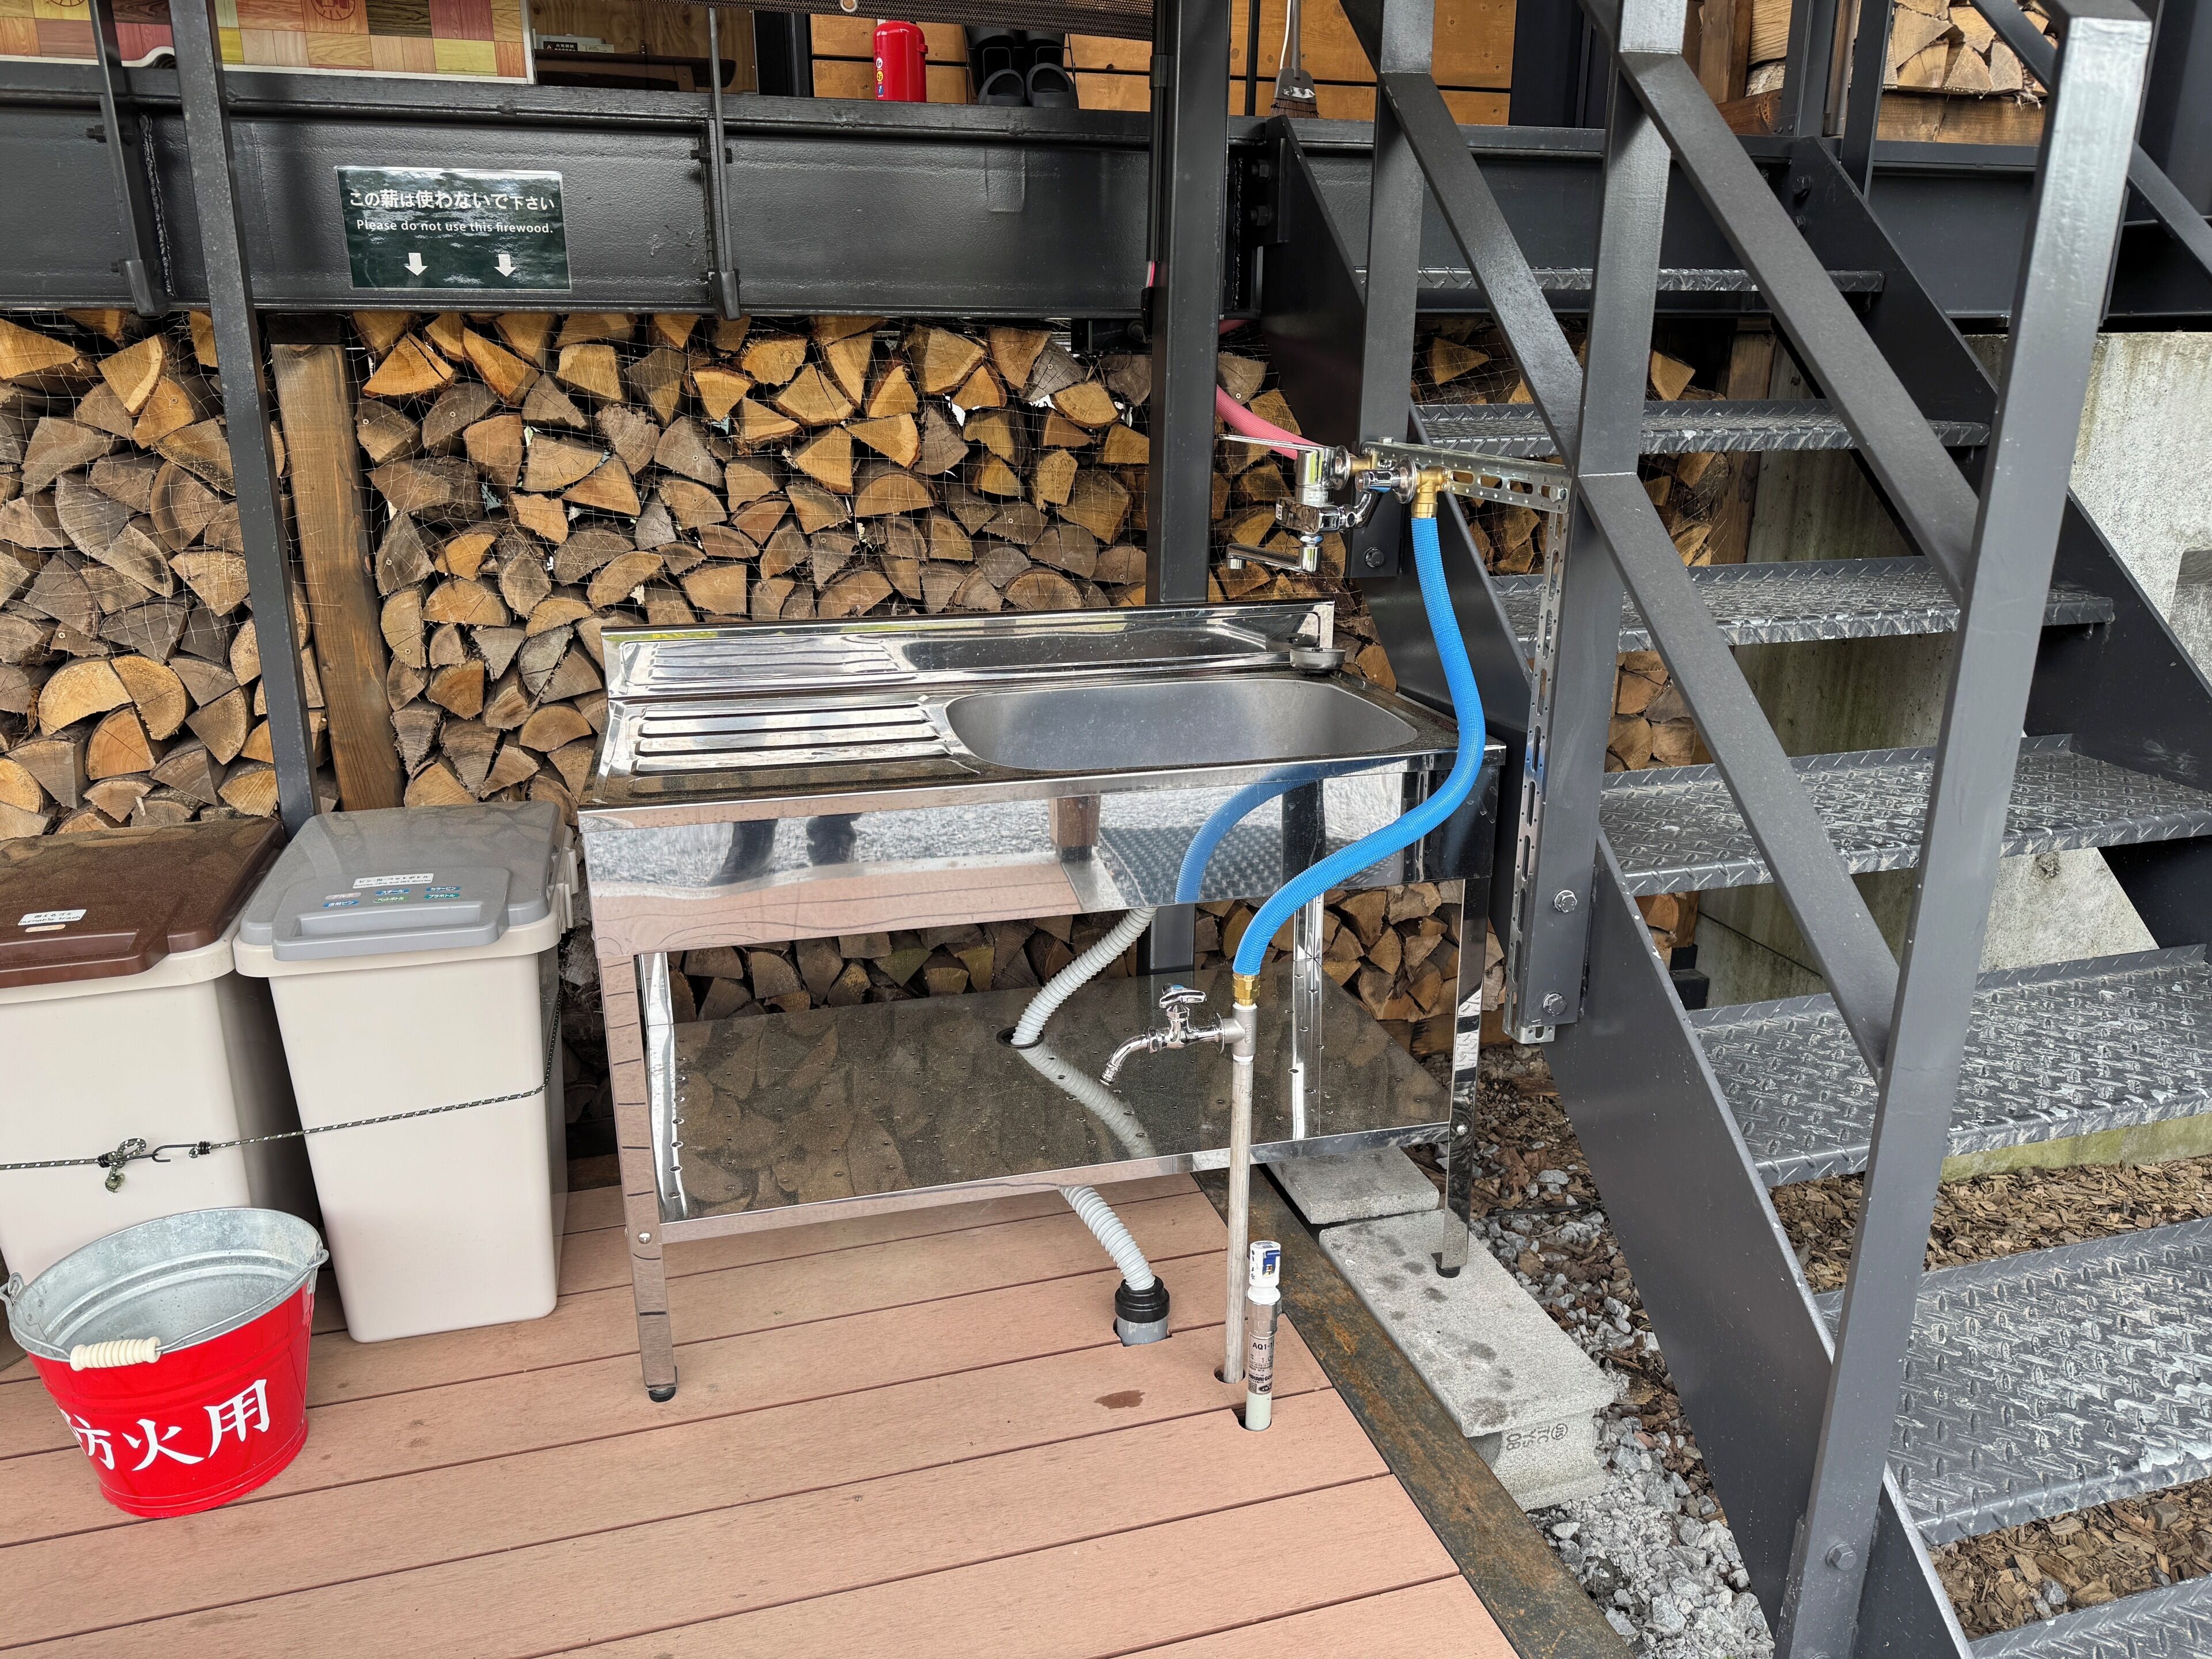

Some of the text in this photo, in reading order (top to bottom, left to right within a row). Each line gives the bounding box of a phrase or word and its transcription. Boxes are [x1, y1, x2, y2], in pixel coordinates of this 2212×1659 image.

[350, 189, 555, 210] この薪は使わないで下さい
[357, 219, 397, 230] Please
[401, 220, 416, 230] do
[421, 222, 441, 231] not
[470, 222, 492, 232] this
[497, 222, 553, 233] firewood.
